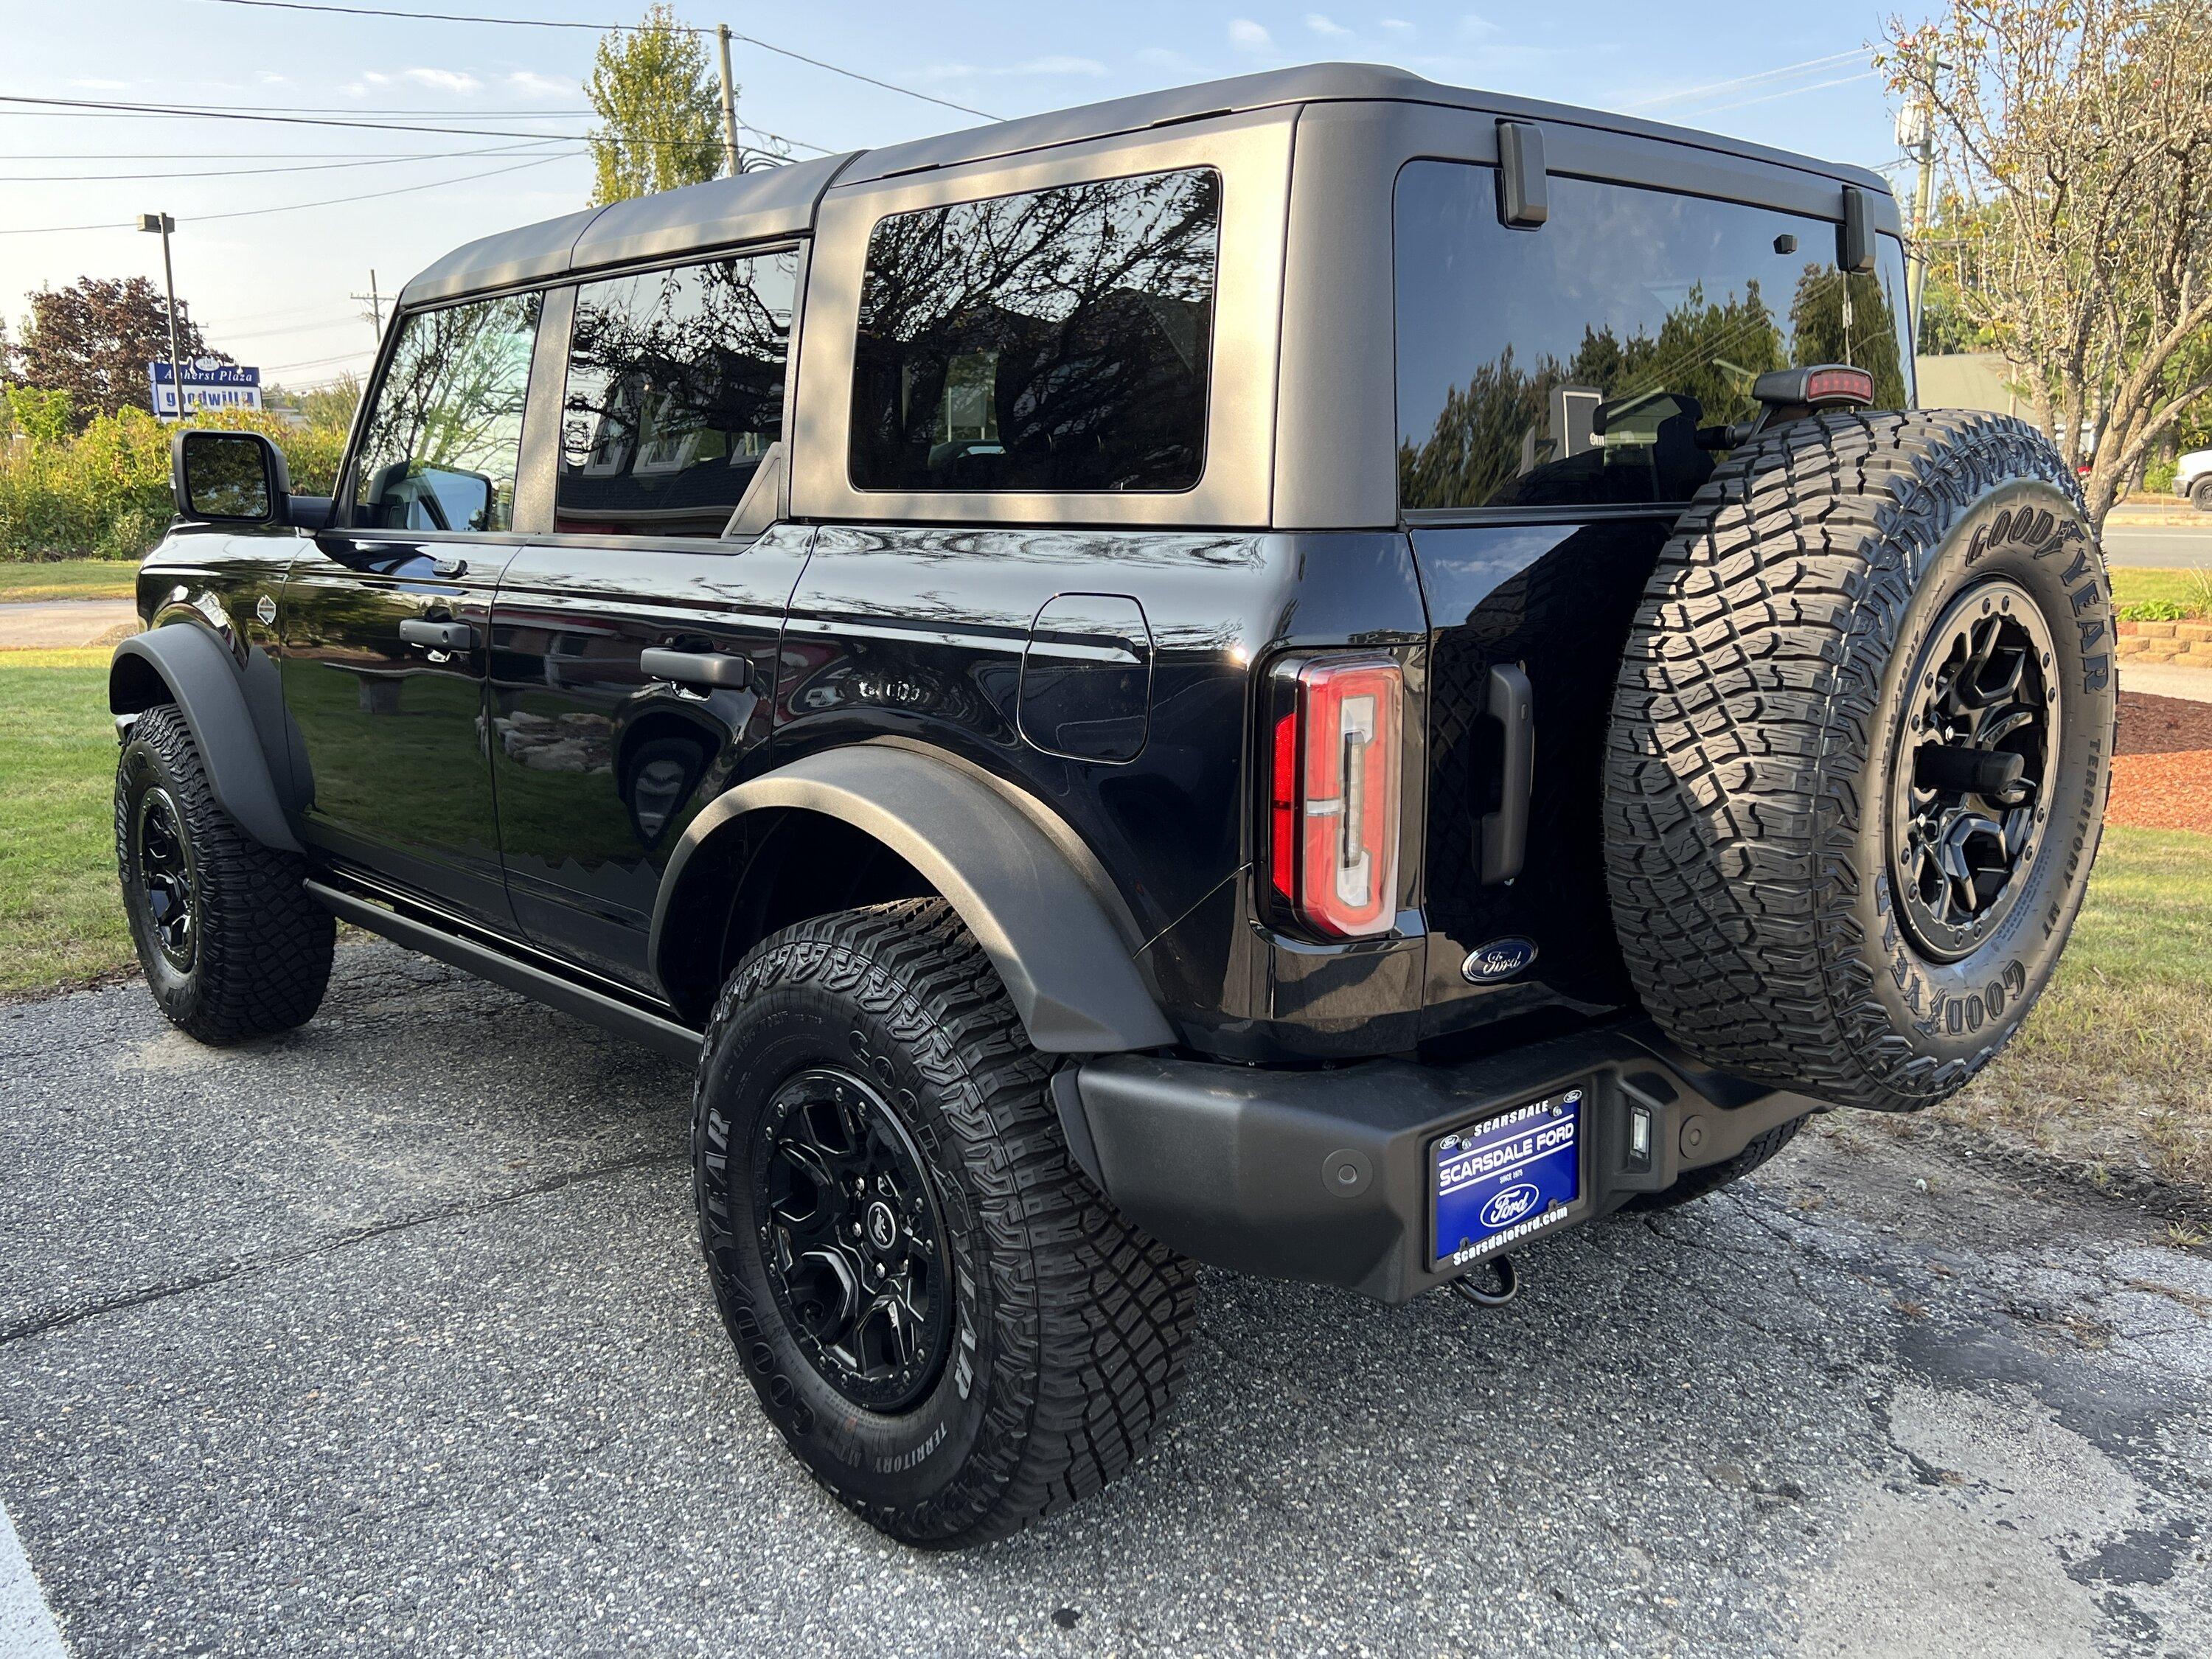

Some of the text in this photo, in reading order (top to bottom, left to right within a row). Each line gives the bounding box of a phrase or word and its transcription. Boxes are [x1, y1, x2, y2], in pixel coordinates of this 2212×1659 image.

[164, 370, 252, 382] Aherst Plaza
[2042, 738, 2101, 940] TERRITORY MT
[1474, 1099, 1549, 1138] SCARSDALE
[1439, 1122, 1574, 1188] SCARSDALE FORD
[1490, 1189, 1530, 1224] Ford
[1453, 1206, 1568, 1266] ScarsdaleFord.com
[873, 1420, 948, 1474] TERRITORY
